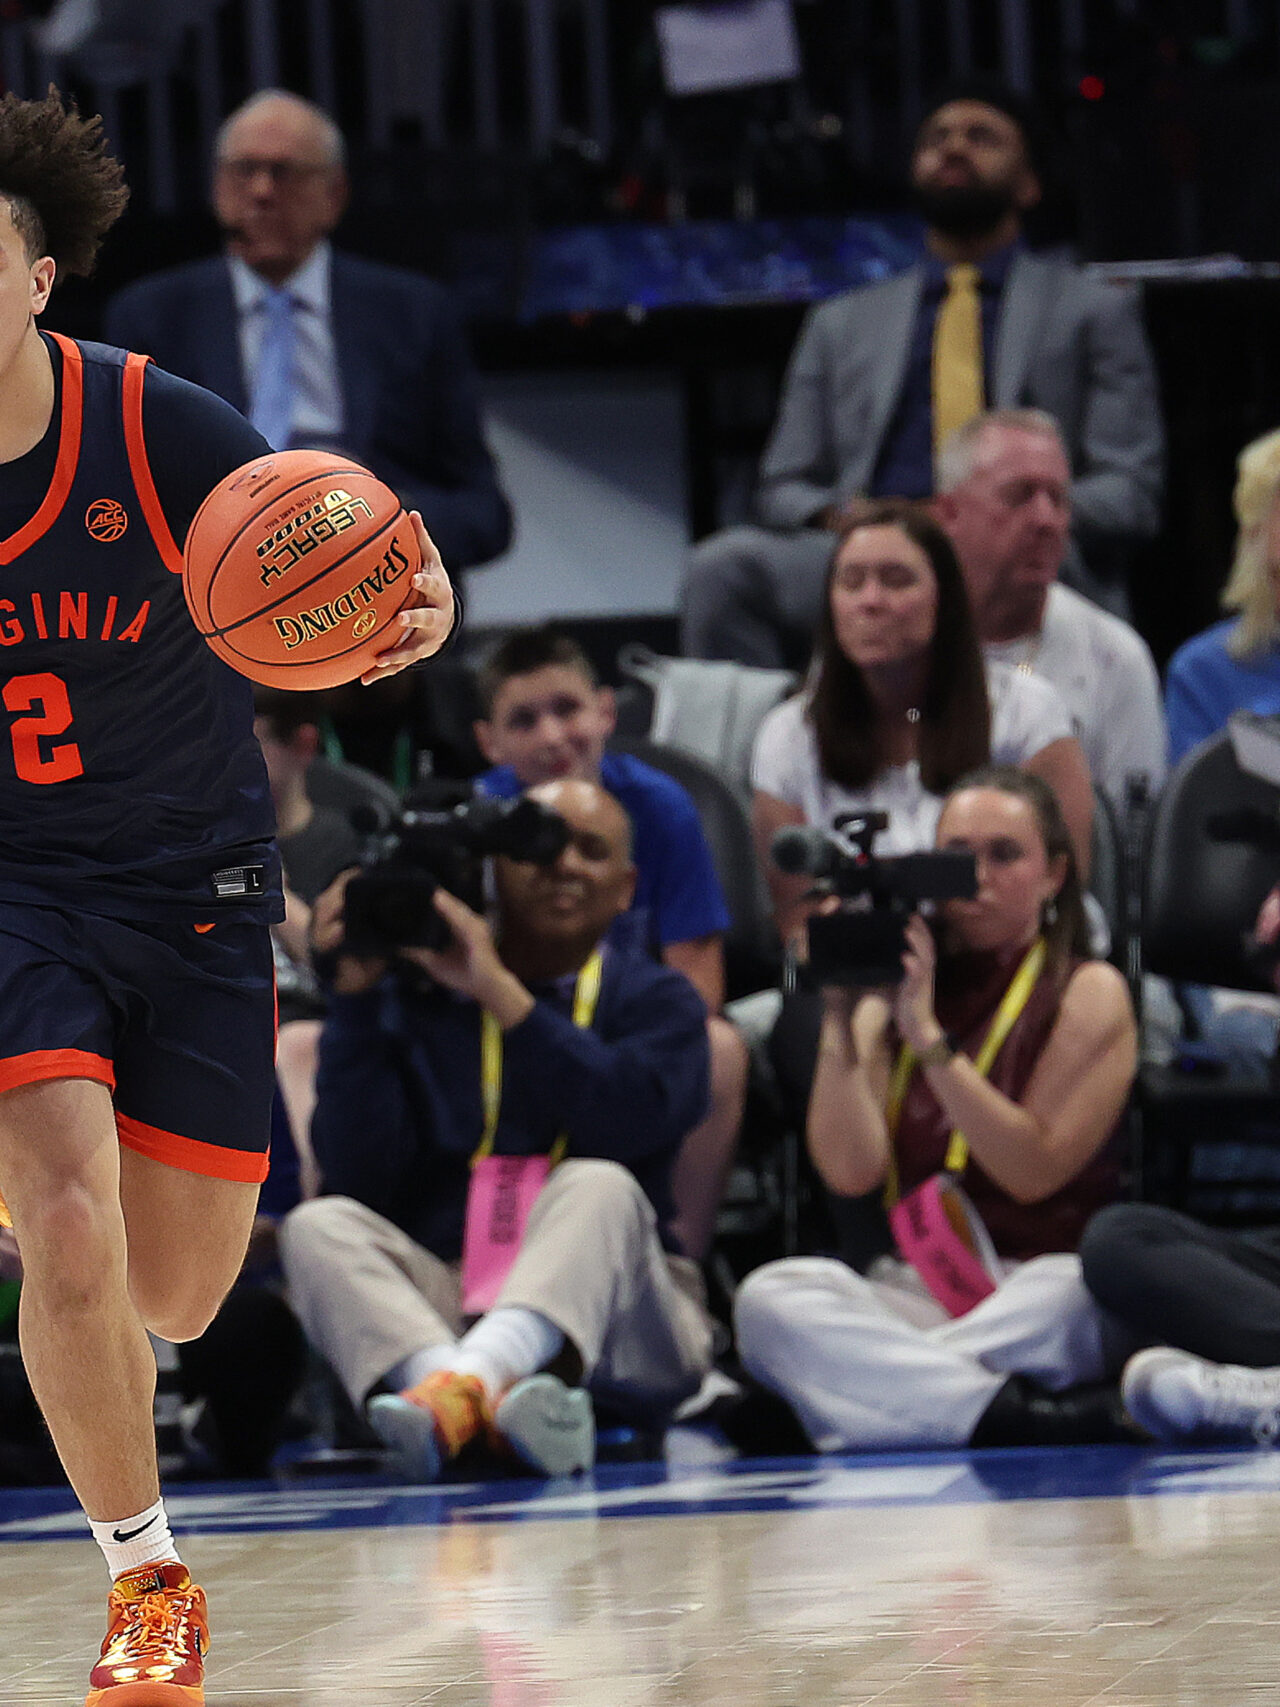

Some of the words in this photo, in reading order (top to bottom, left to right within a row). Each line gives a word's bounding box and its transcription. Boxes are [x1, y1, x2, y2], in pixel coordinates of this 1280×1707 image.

[260, 497, 375, 589] LEGACY
[272, 537, 409, 651] SPALDING
[1, 672, 84, 785] 2
[253, 873, 260, 887] L
